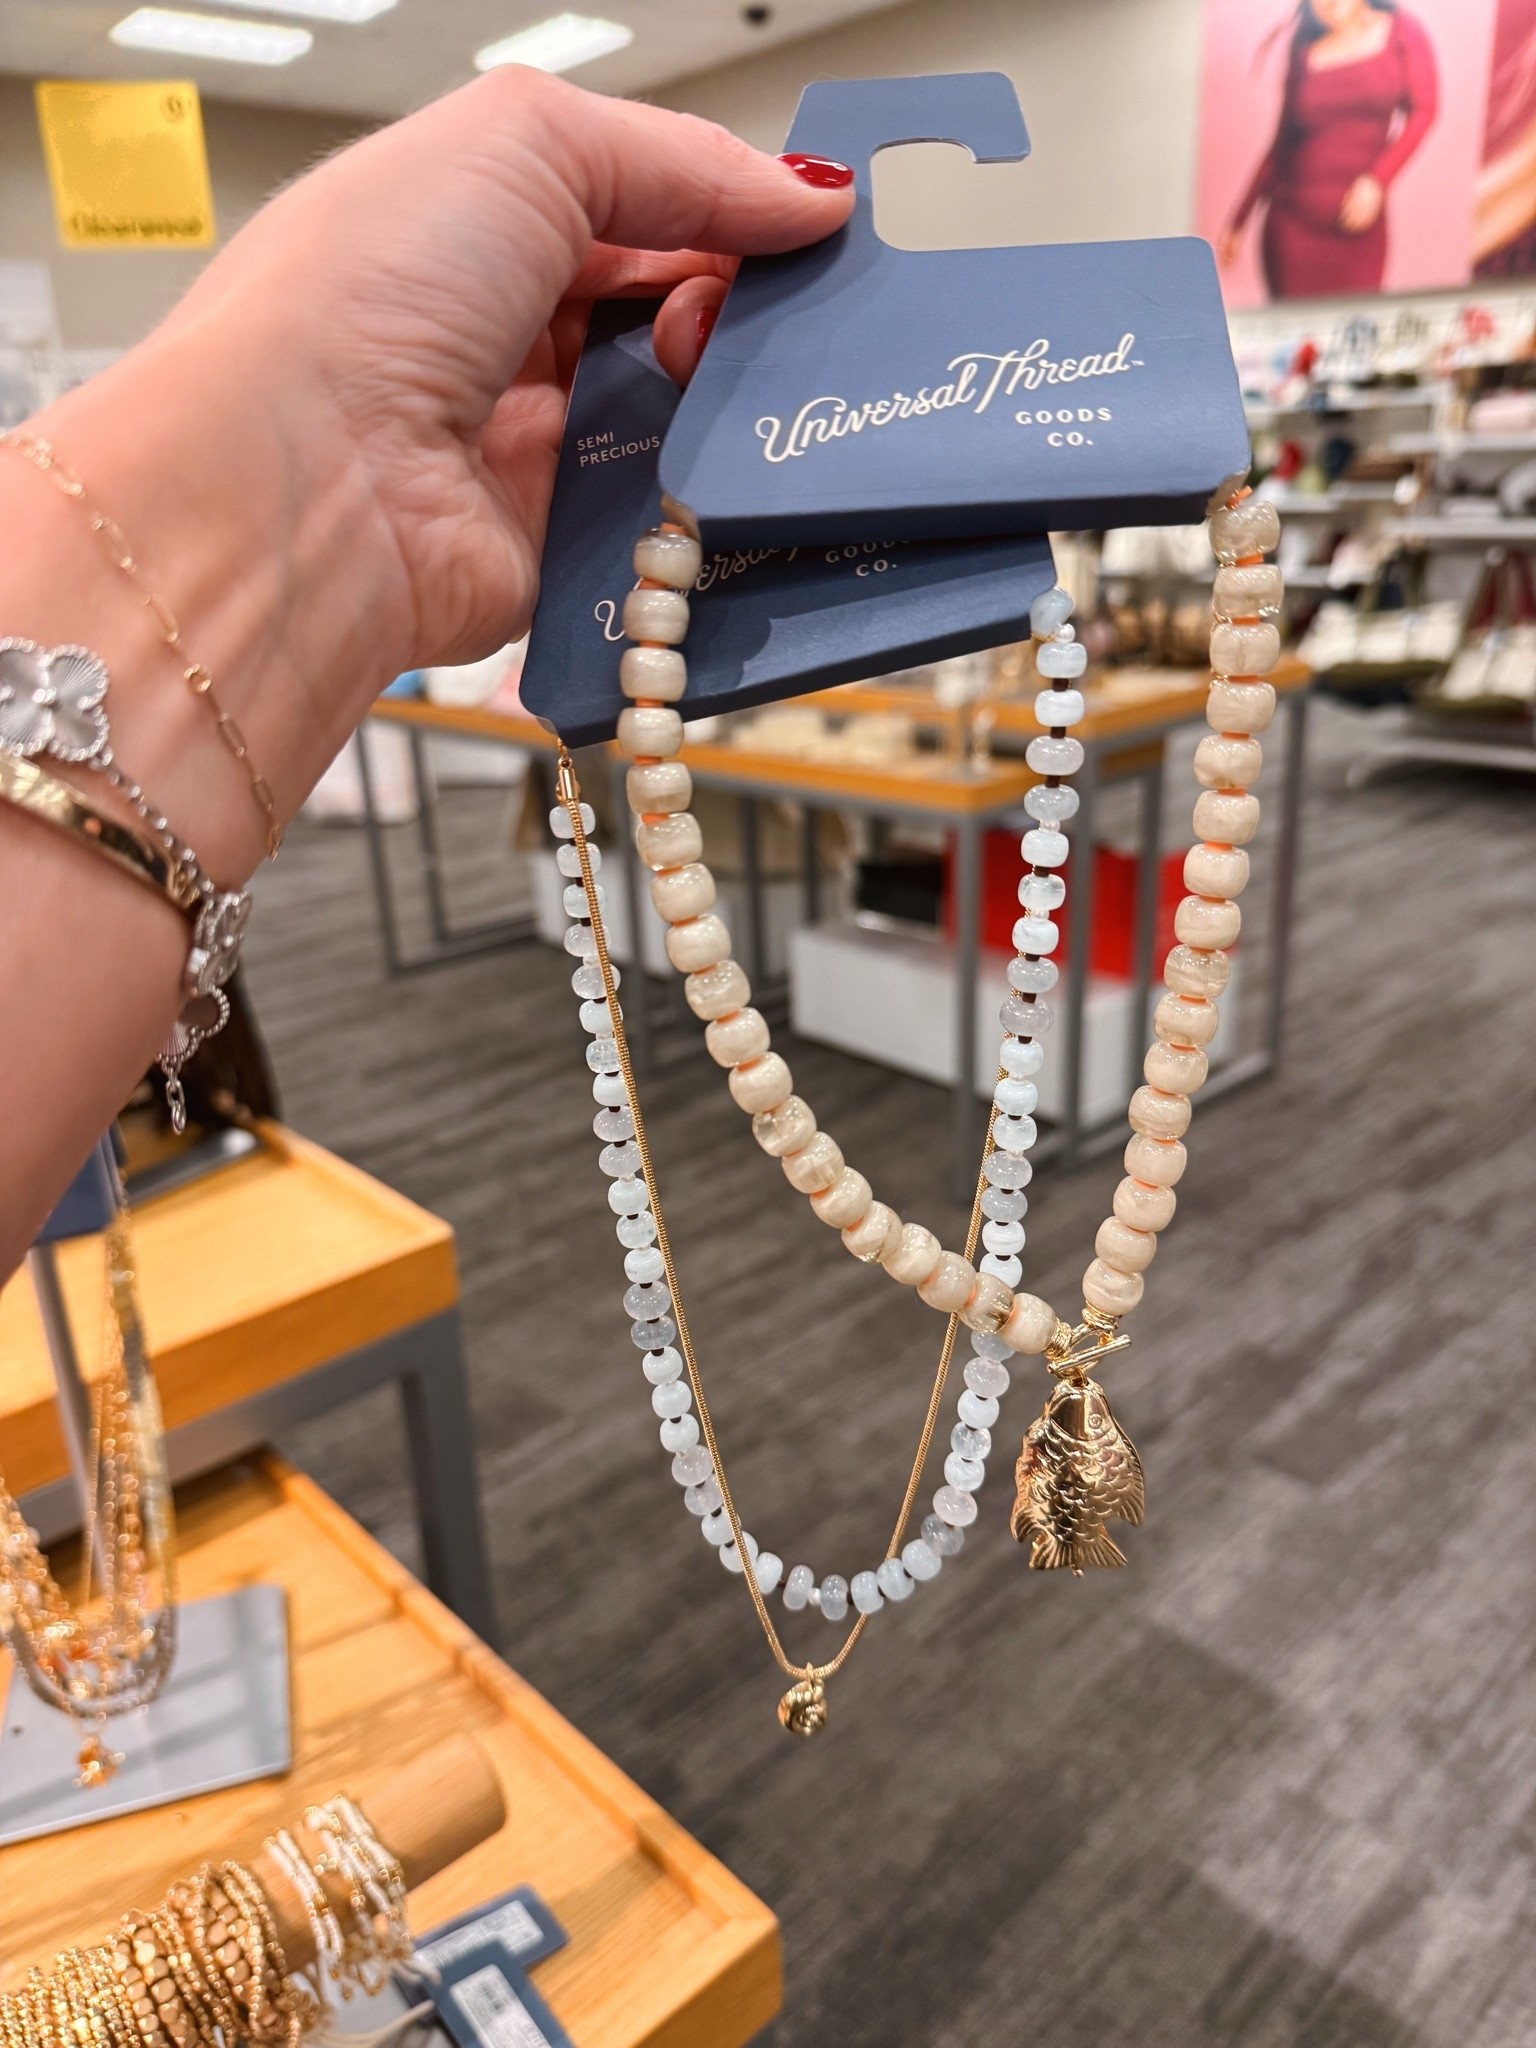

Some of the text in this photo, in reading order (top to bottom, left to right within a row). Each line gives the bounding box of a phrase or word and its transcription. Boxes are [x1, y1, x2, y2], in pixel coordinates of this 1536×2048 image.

[754, 362, 977, 463] Universal
[1014, 407, 1113, 425] GOODS
[577, 431, 614, 451] SEMI
[1046, 431, 1095, 447] CO.
[579, 436, 661, 468] PRECIOUS
[824, 540, 911, 563] GOOD
[855, 558, 898, 577] CO.
